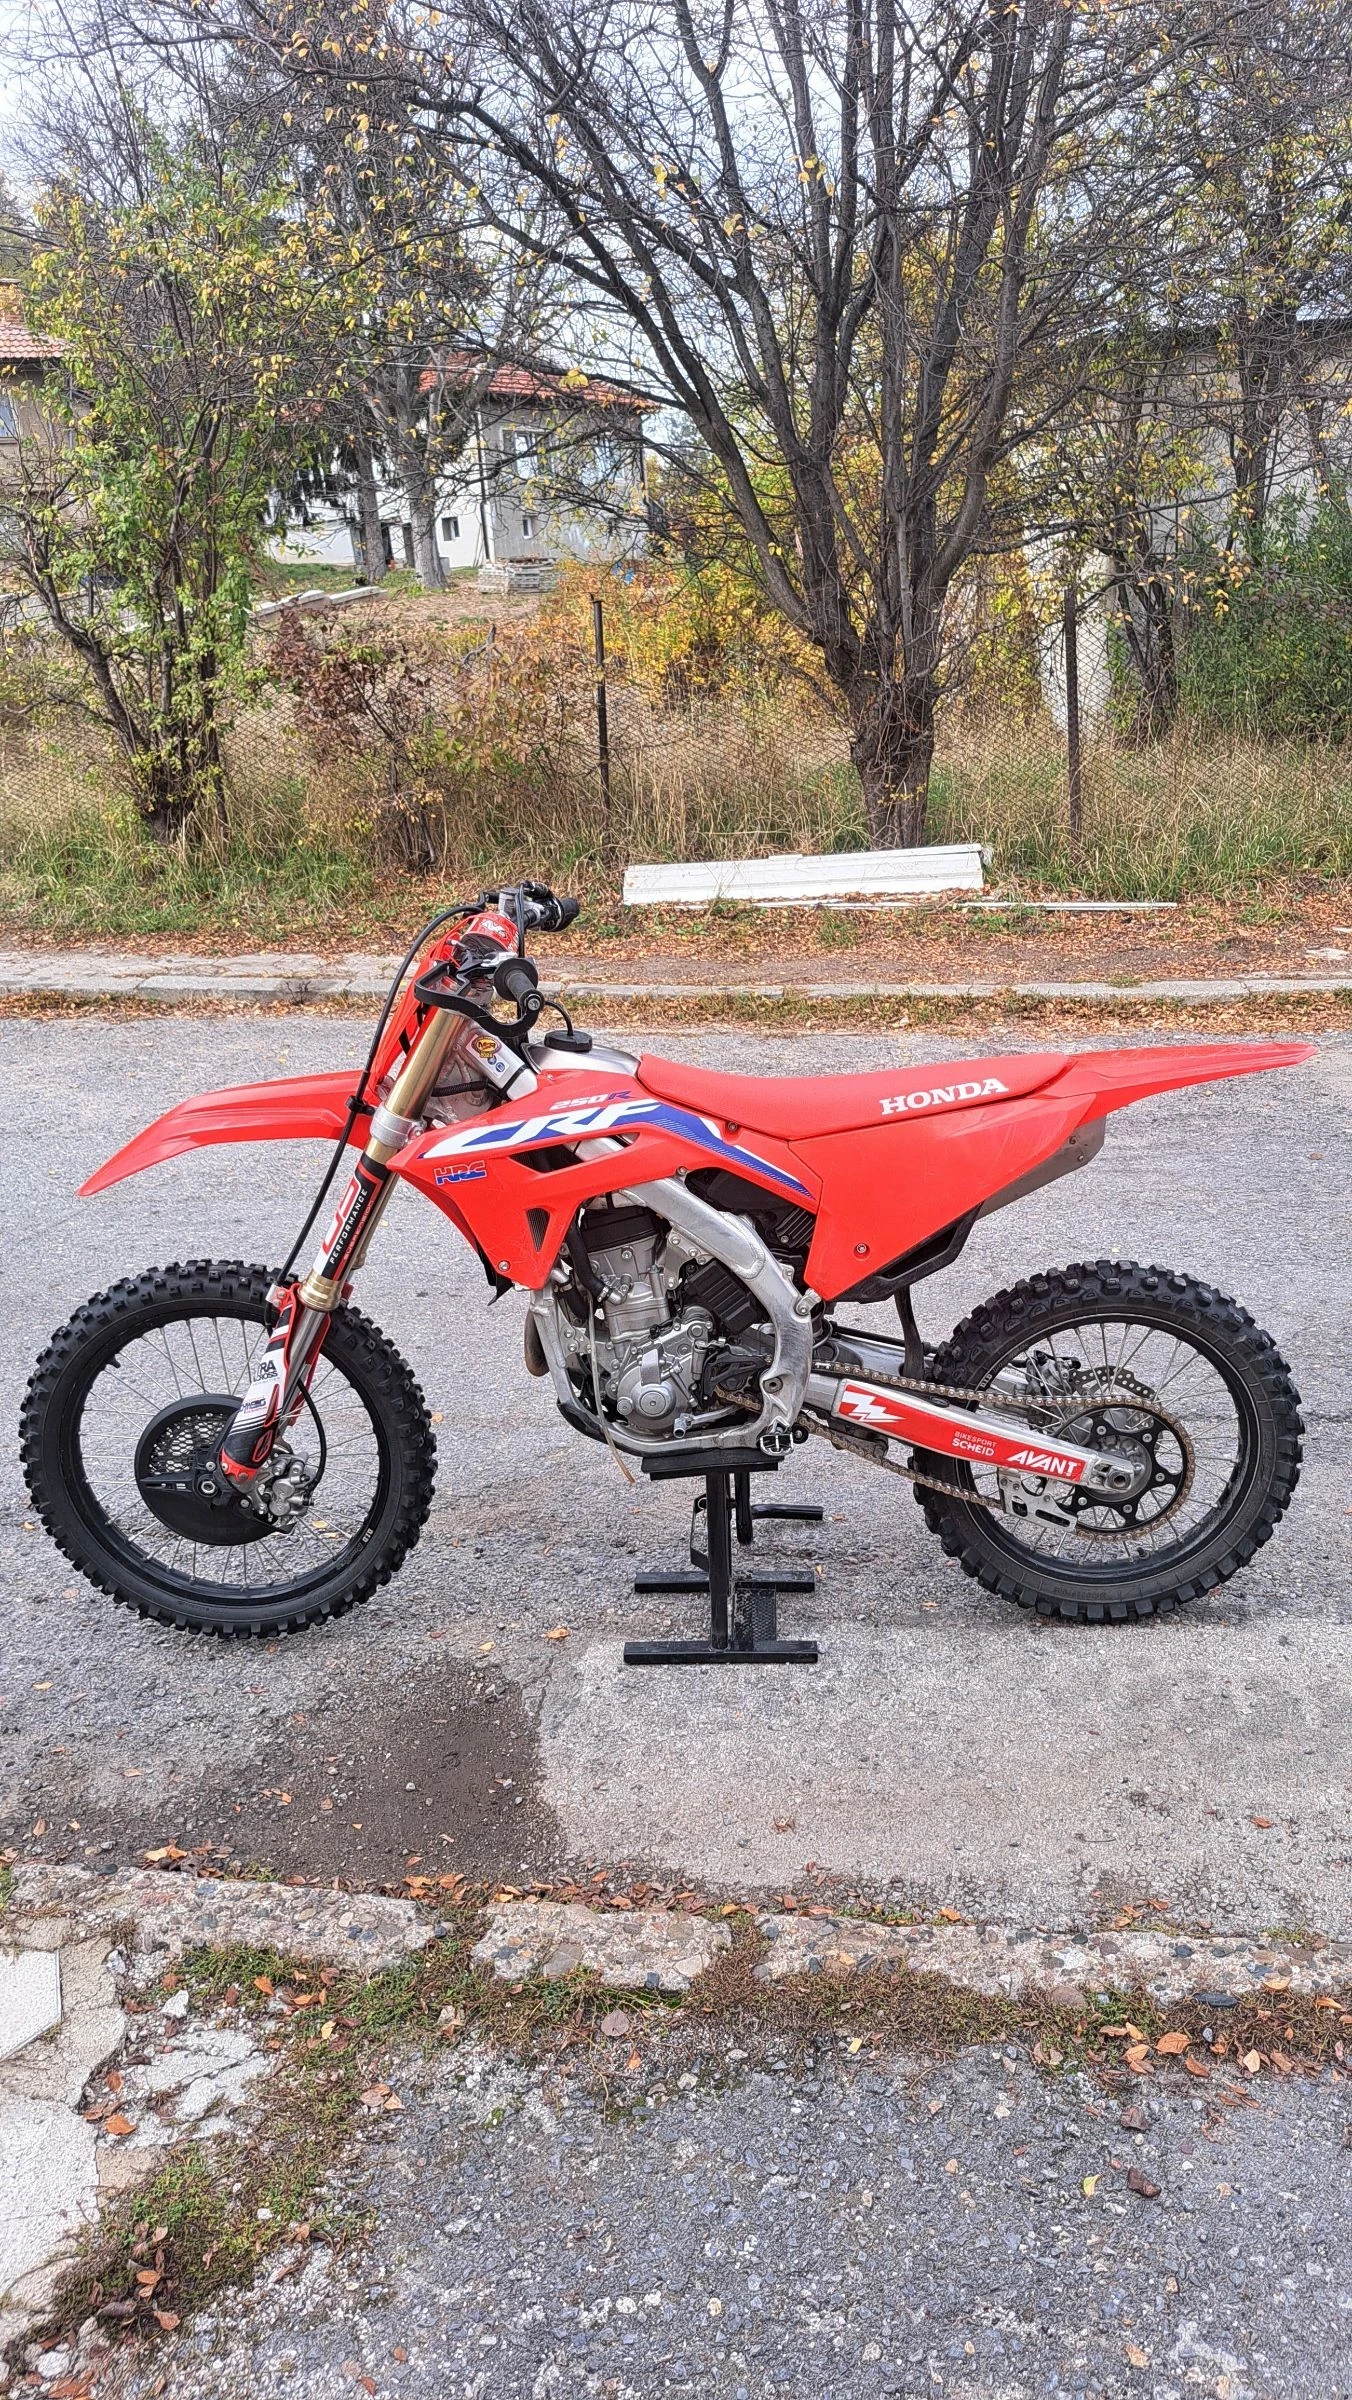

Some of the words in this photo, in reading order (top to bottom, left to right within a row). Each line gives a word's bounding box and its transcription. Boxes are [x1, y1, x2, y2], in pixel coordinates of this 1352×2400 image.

[549, 1091, 634, 1111] 250R
[880, 1078, 1009, 1115] HONDA
[419, 1099, 661, 1159] CRF
[434, 1160, 487, 1185] HRC
[330, 1188, 368, 1264] PERFORMANCE
[952, 1438, 994, 1456] SCHEID
[955, 1431, 997, 1448] BIKESPORT
[1007, 1450, 1078, 1477] AVANT
